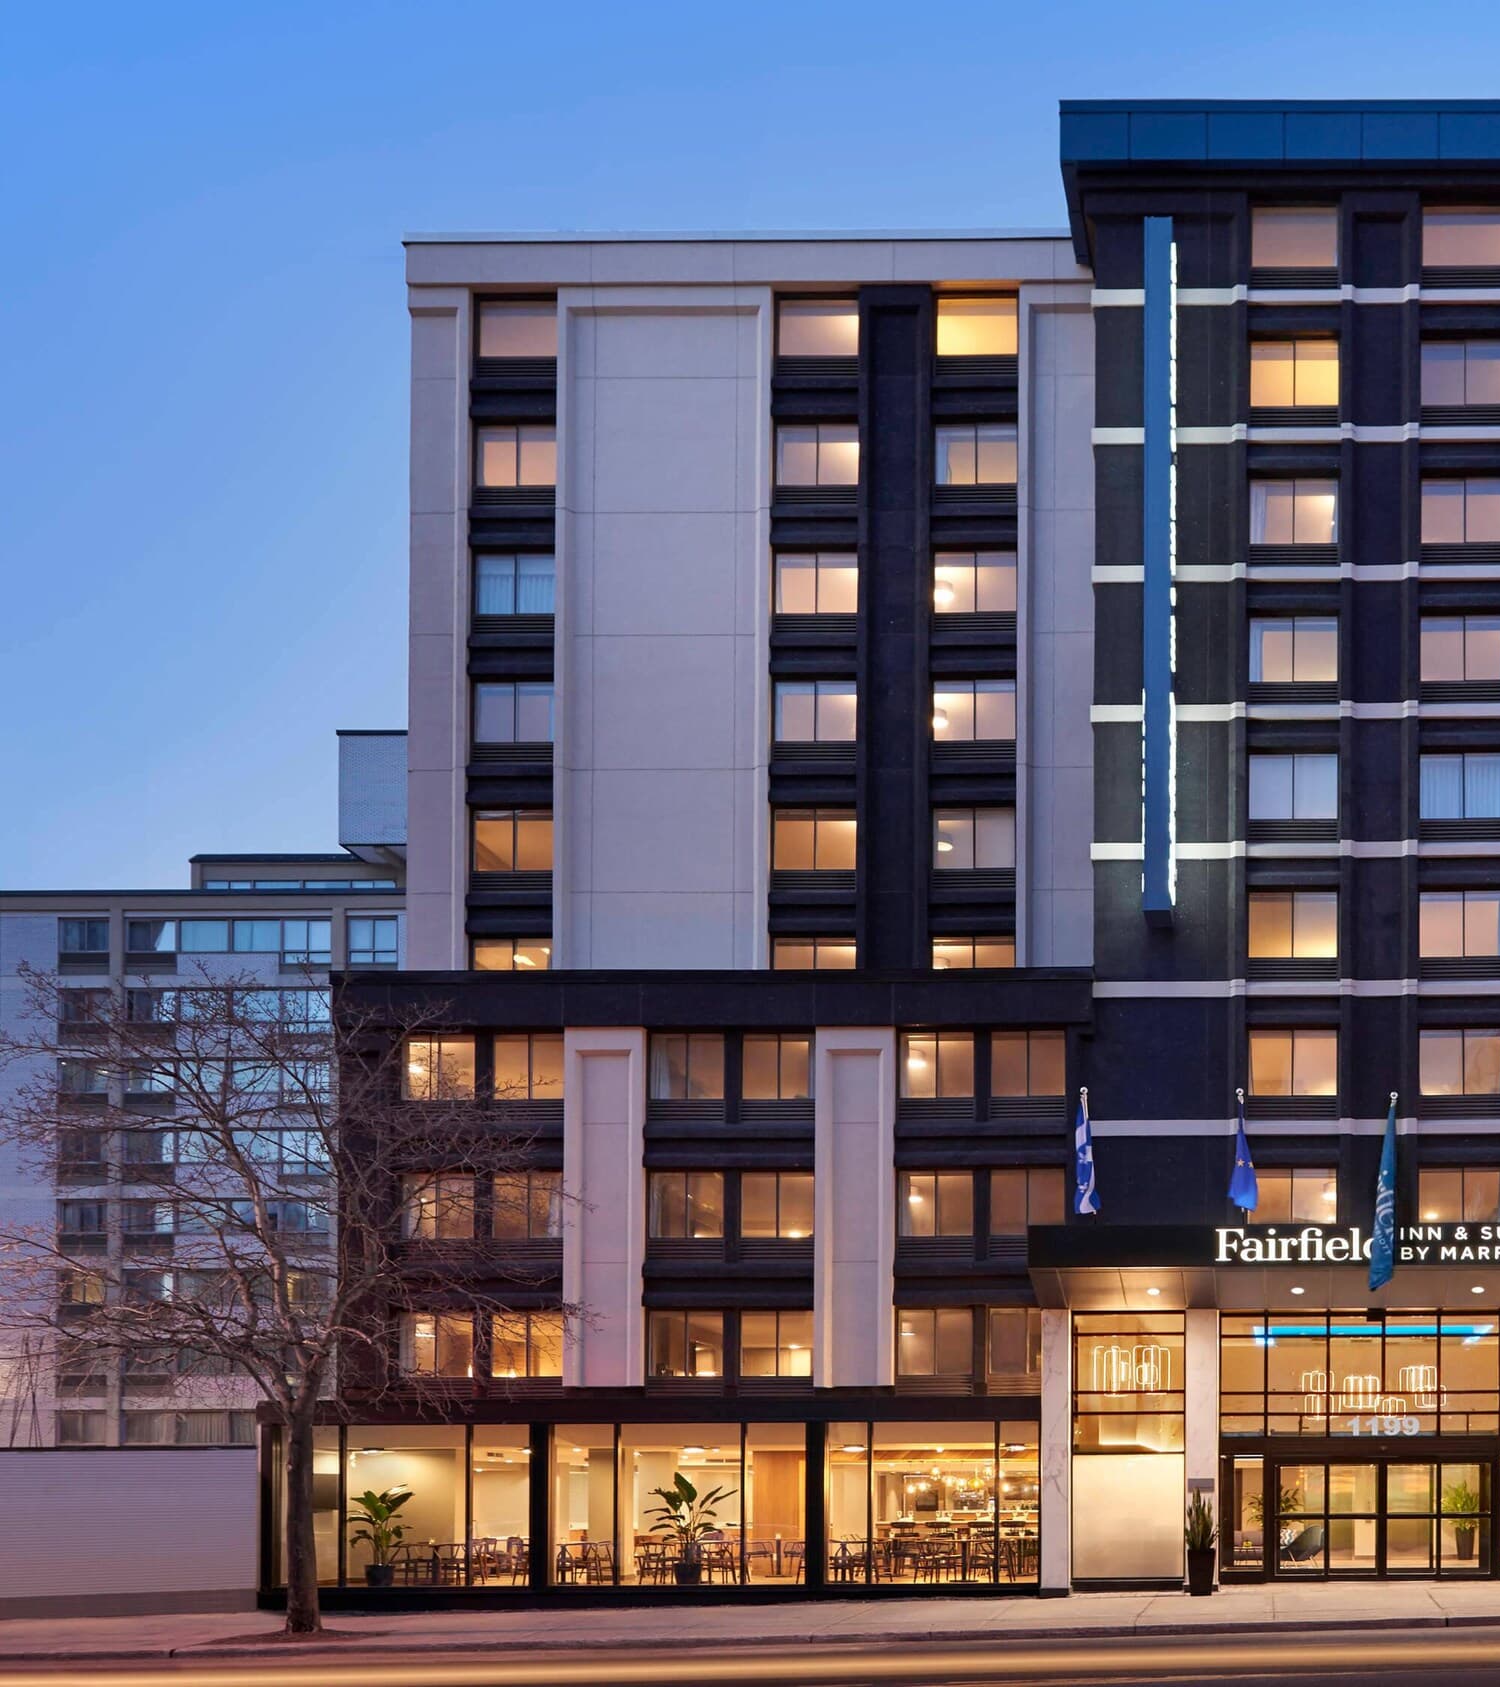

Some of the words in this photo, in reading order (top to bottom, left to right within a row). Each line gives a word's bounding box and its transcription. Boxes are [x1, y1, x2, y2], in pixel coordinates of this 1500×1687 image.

[1401, 1227, 1441, 1240] INN
[1455, 1226, 1468, 1240] &
[1401, 1247, 1430, 1260] BY
[1347, 1416, 1419, 1436] 1199
